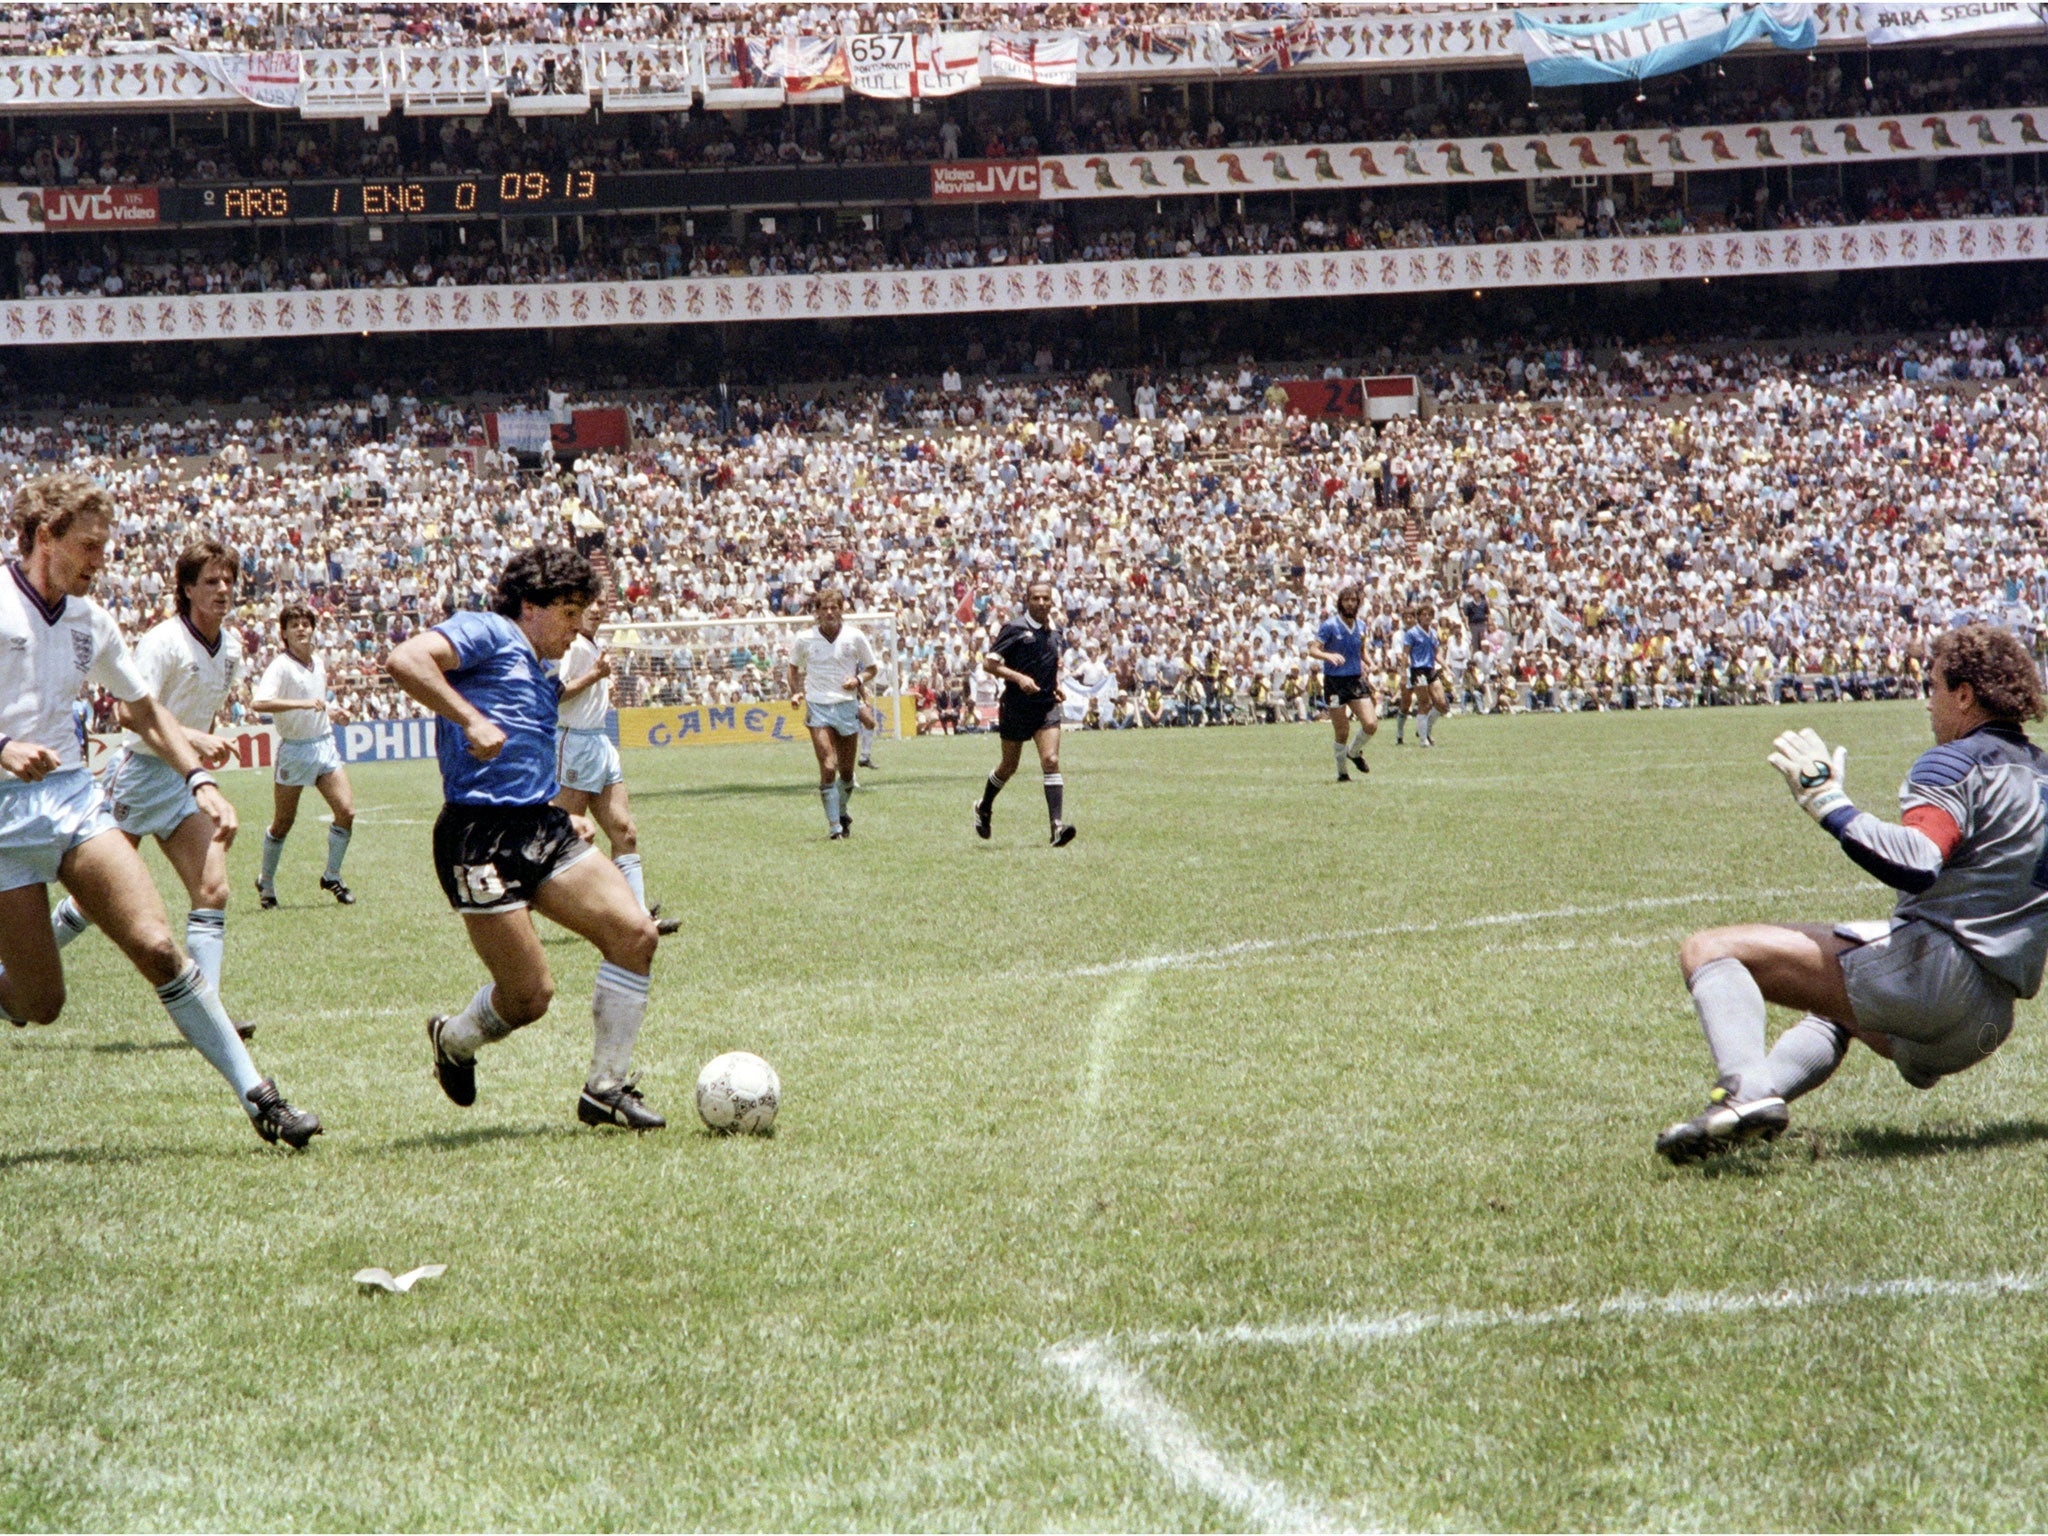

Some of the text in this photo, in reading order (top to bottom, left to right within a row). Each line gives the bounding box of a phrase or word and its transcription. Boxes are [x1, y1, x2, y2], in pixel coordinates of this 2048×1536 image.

[851, 35, 905, 62] 657
[854, 72, 905, 90] HULL
[934, 167, 976, 181] Video
[934, 180, 976, 194] Movie
[975, 165, 1038, 192] JVC
[47, 194, 113, 221] JVC
[113, 206, 156, 220] Video
[225, 187, 288, 217] ARG
[363, 184, 425, 213] ENG
[455, 182, 476, 210] 0
[648, 706, 793, 747] CAMEL
